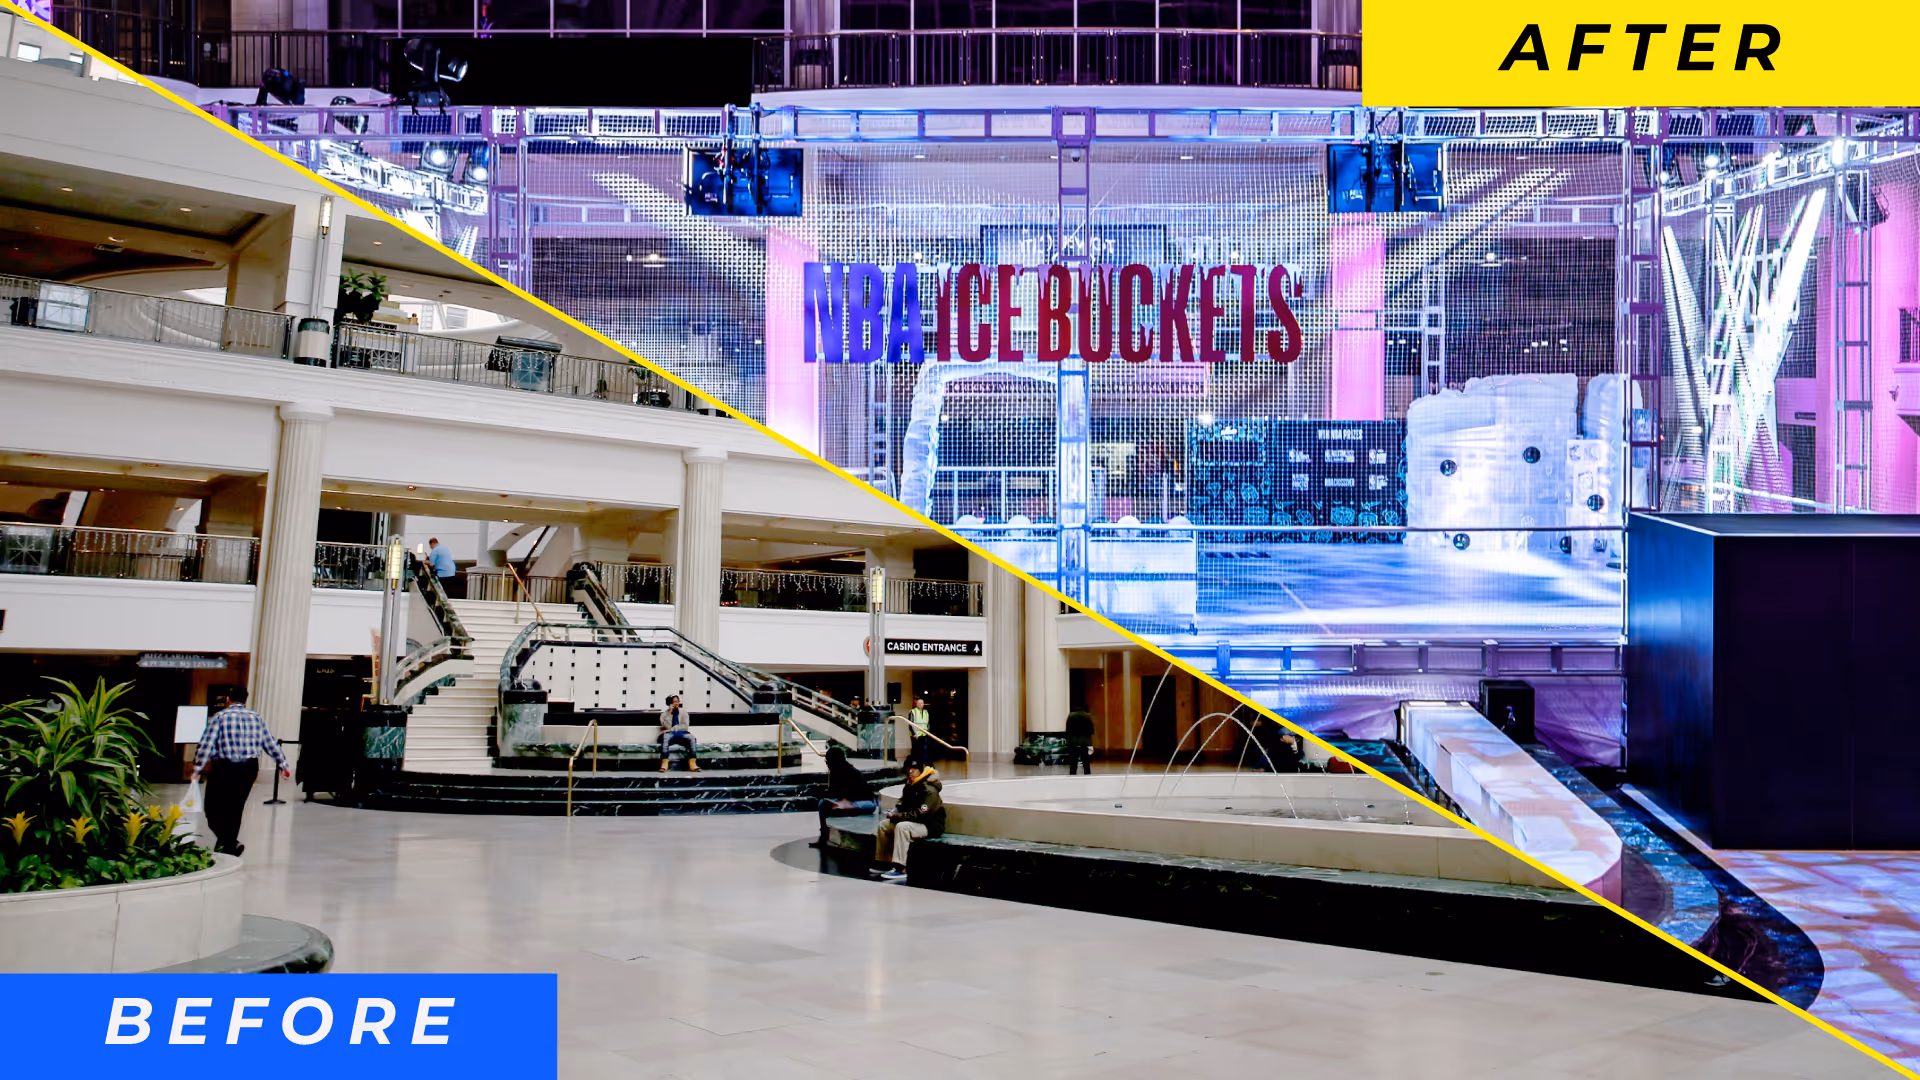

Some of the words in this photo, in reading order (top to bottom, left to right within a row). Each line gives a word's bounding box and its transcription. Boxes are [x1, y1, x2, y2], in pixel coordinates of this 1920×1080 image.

[804, 262, 924, 364] NBA
[937, 263, 1026, 364] ICE
[1038, 263, 1303, 364] BUCKETS
[1343, 429, 1363, 440] PRIZES
[887, 642, 920, 651] CASINO
[922, 643, 967, 652] ENTRANCE
